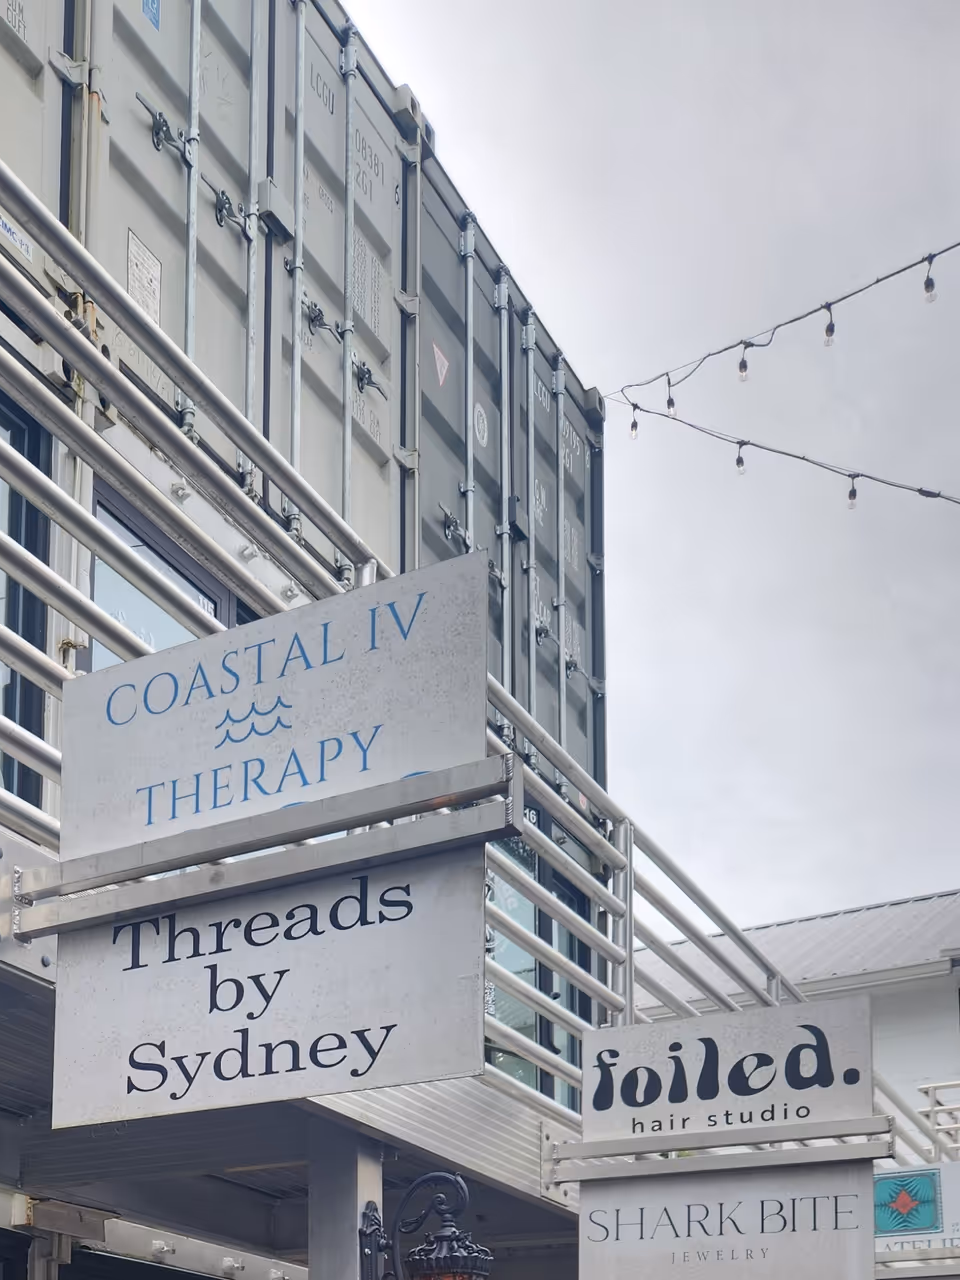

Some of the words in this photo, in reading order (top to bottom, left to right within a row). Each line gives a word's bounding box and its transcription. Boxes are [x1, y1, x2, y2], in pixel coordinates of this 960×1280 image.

[310, 63, 335, 115] LCGU
[106, 621, 346, 726] COASTAL
[369, 591, 428, 651] IV
[136, 724, 384, 826] THERAPY
[112, 876, 414, 971] Threads
[204, 963, 290, 1020] by
[127, 1024, 398, 1101] Sydney
[592, 1024, 861, 1111] foiled.
[631, 1114, 691, 1134] hair
[707, 1104, 811, 1127] studio
[587, 1201, 747, 1243] SHARK
[759, 1194, 860, 1235] BITE
[671, 1247, 770, 1265] JEWELRY
